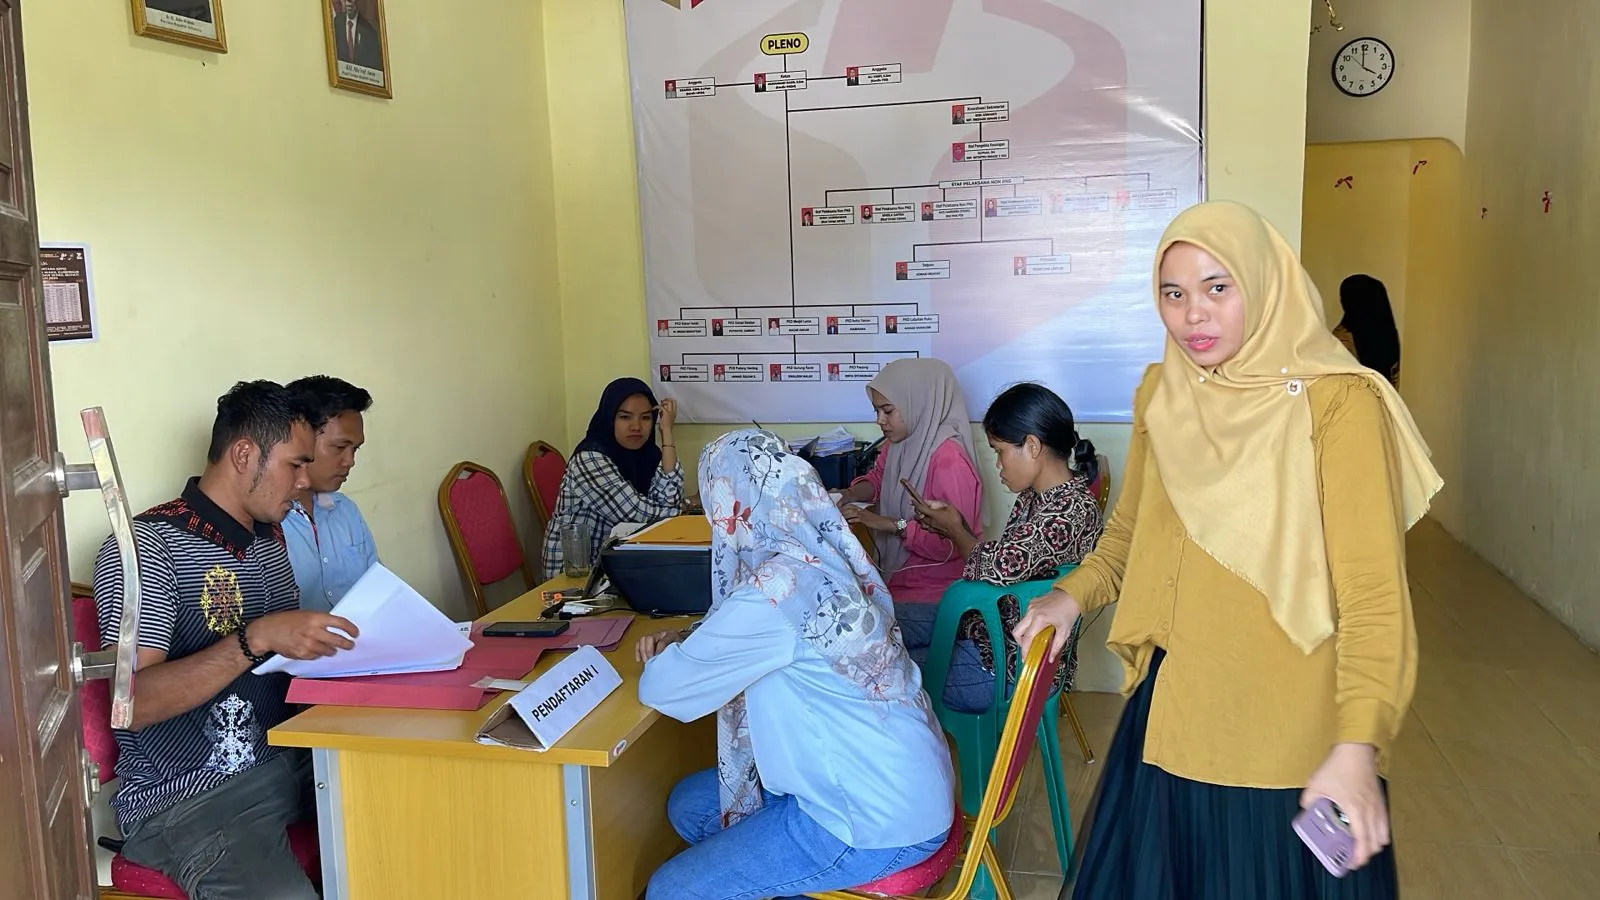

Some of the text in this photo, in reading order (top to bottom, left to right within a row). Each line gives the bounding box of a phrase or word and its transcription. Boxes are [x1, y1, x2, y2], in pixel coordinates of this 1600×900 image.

[768, 38, 801, 50] PLENO
[1380, 53, 1385, 61] 2
[531, 664, 599, 722] PENDAFTARAN I
